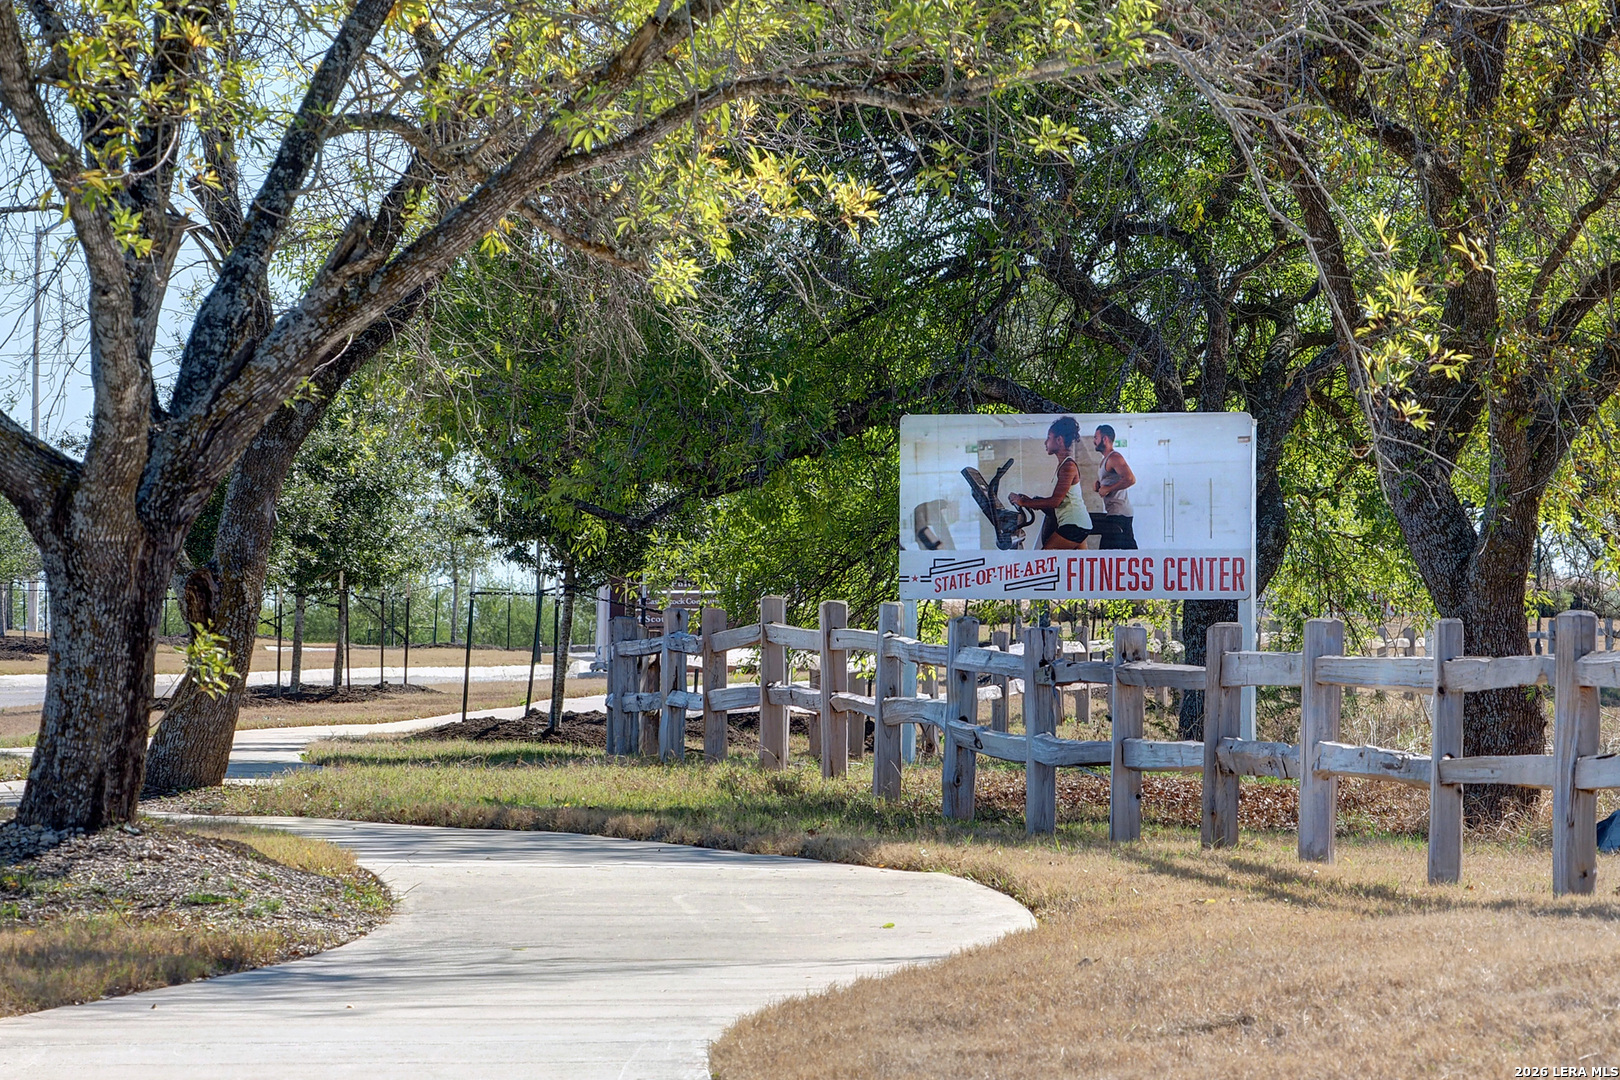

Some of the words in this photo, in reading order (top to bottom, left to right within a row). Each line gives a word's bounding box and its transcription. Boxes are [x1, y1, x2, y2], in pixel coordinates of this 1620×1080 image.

[934, 556, 1058, 593] STATE-OF-THE-ART
[1066, 557, 1154, 592] FITNESS
[1163, 556, 1246, 592] CENTER
